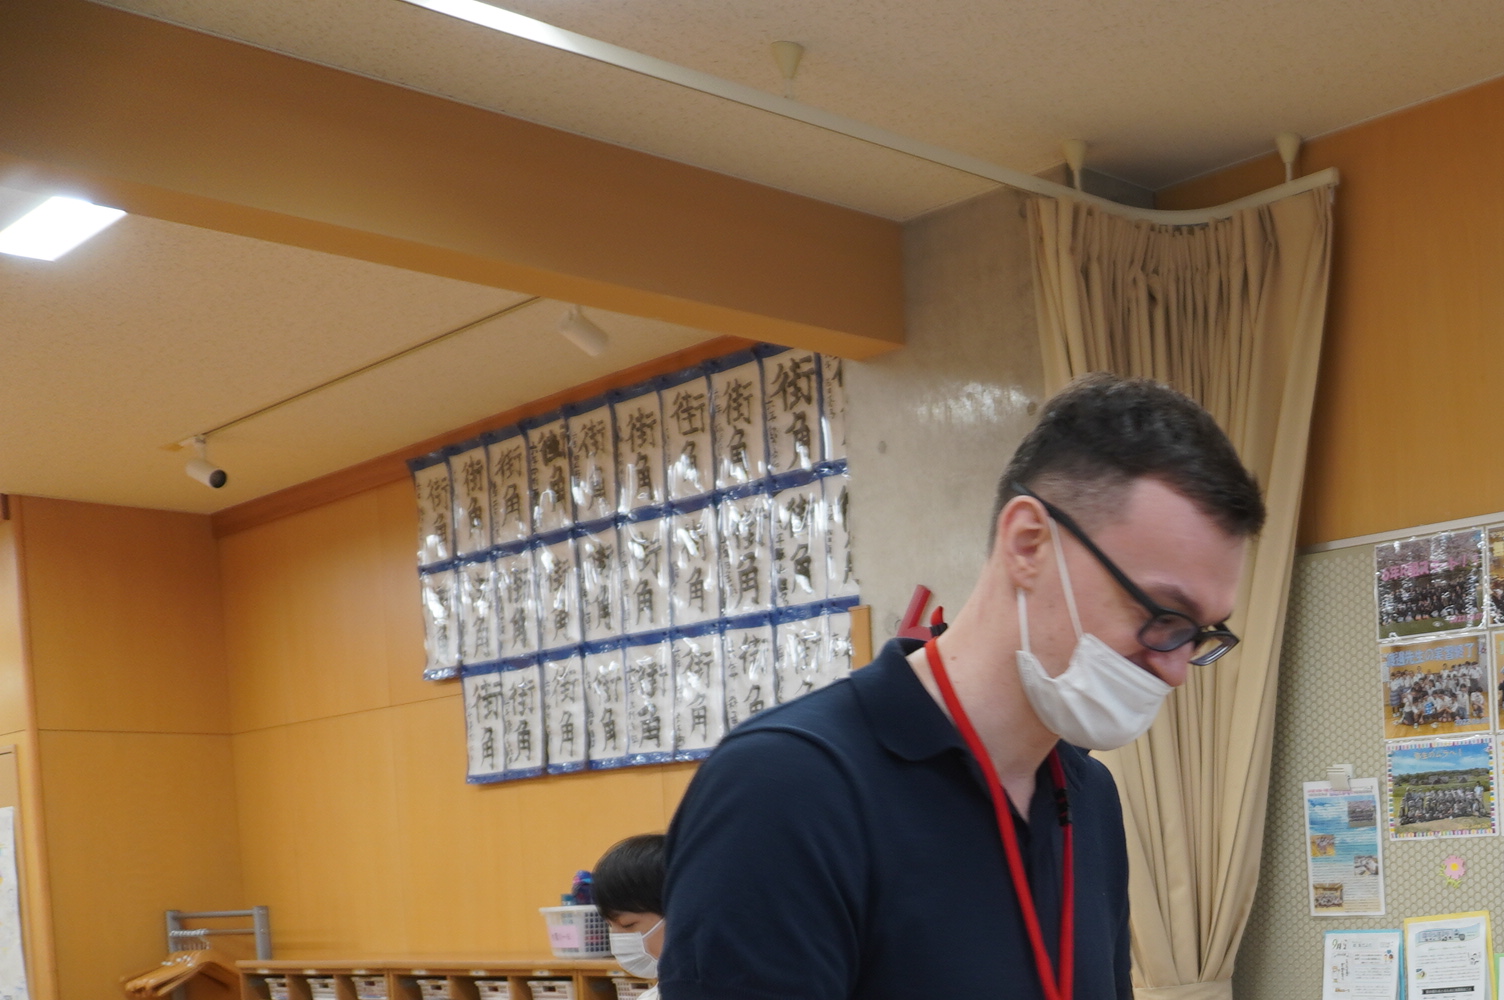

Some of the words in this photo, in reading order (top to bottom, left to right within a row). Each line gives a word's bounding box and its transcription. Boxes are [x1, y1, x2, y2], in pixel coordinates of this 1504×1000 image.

[624, 406, 658, 500] 街角
[722, 378, 753, 472] 街角
[770, 355, 815, 470] 街角
[461, 456, 484, 540] 街角
[495, 444, 522, 527] 街角
[473, 680, 503, 770] 街角
[509, 678, 535, 763] 街角
[553, 667, 577, 757] 街角
